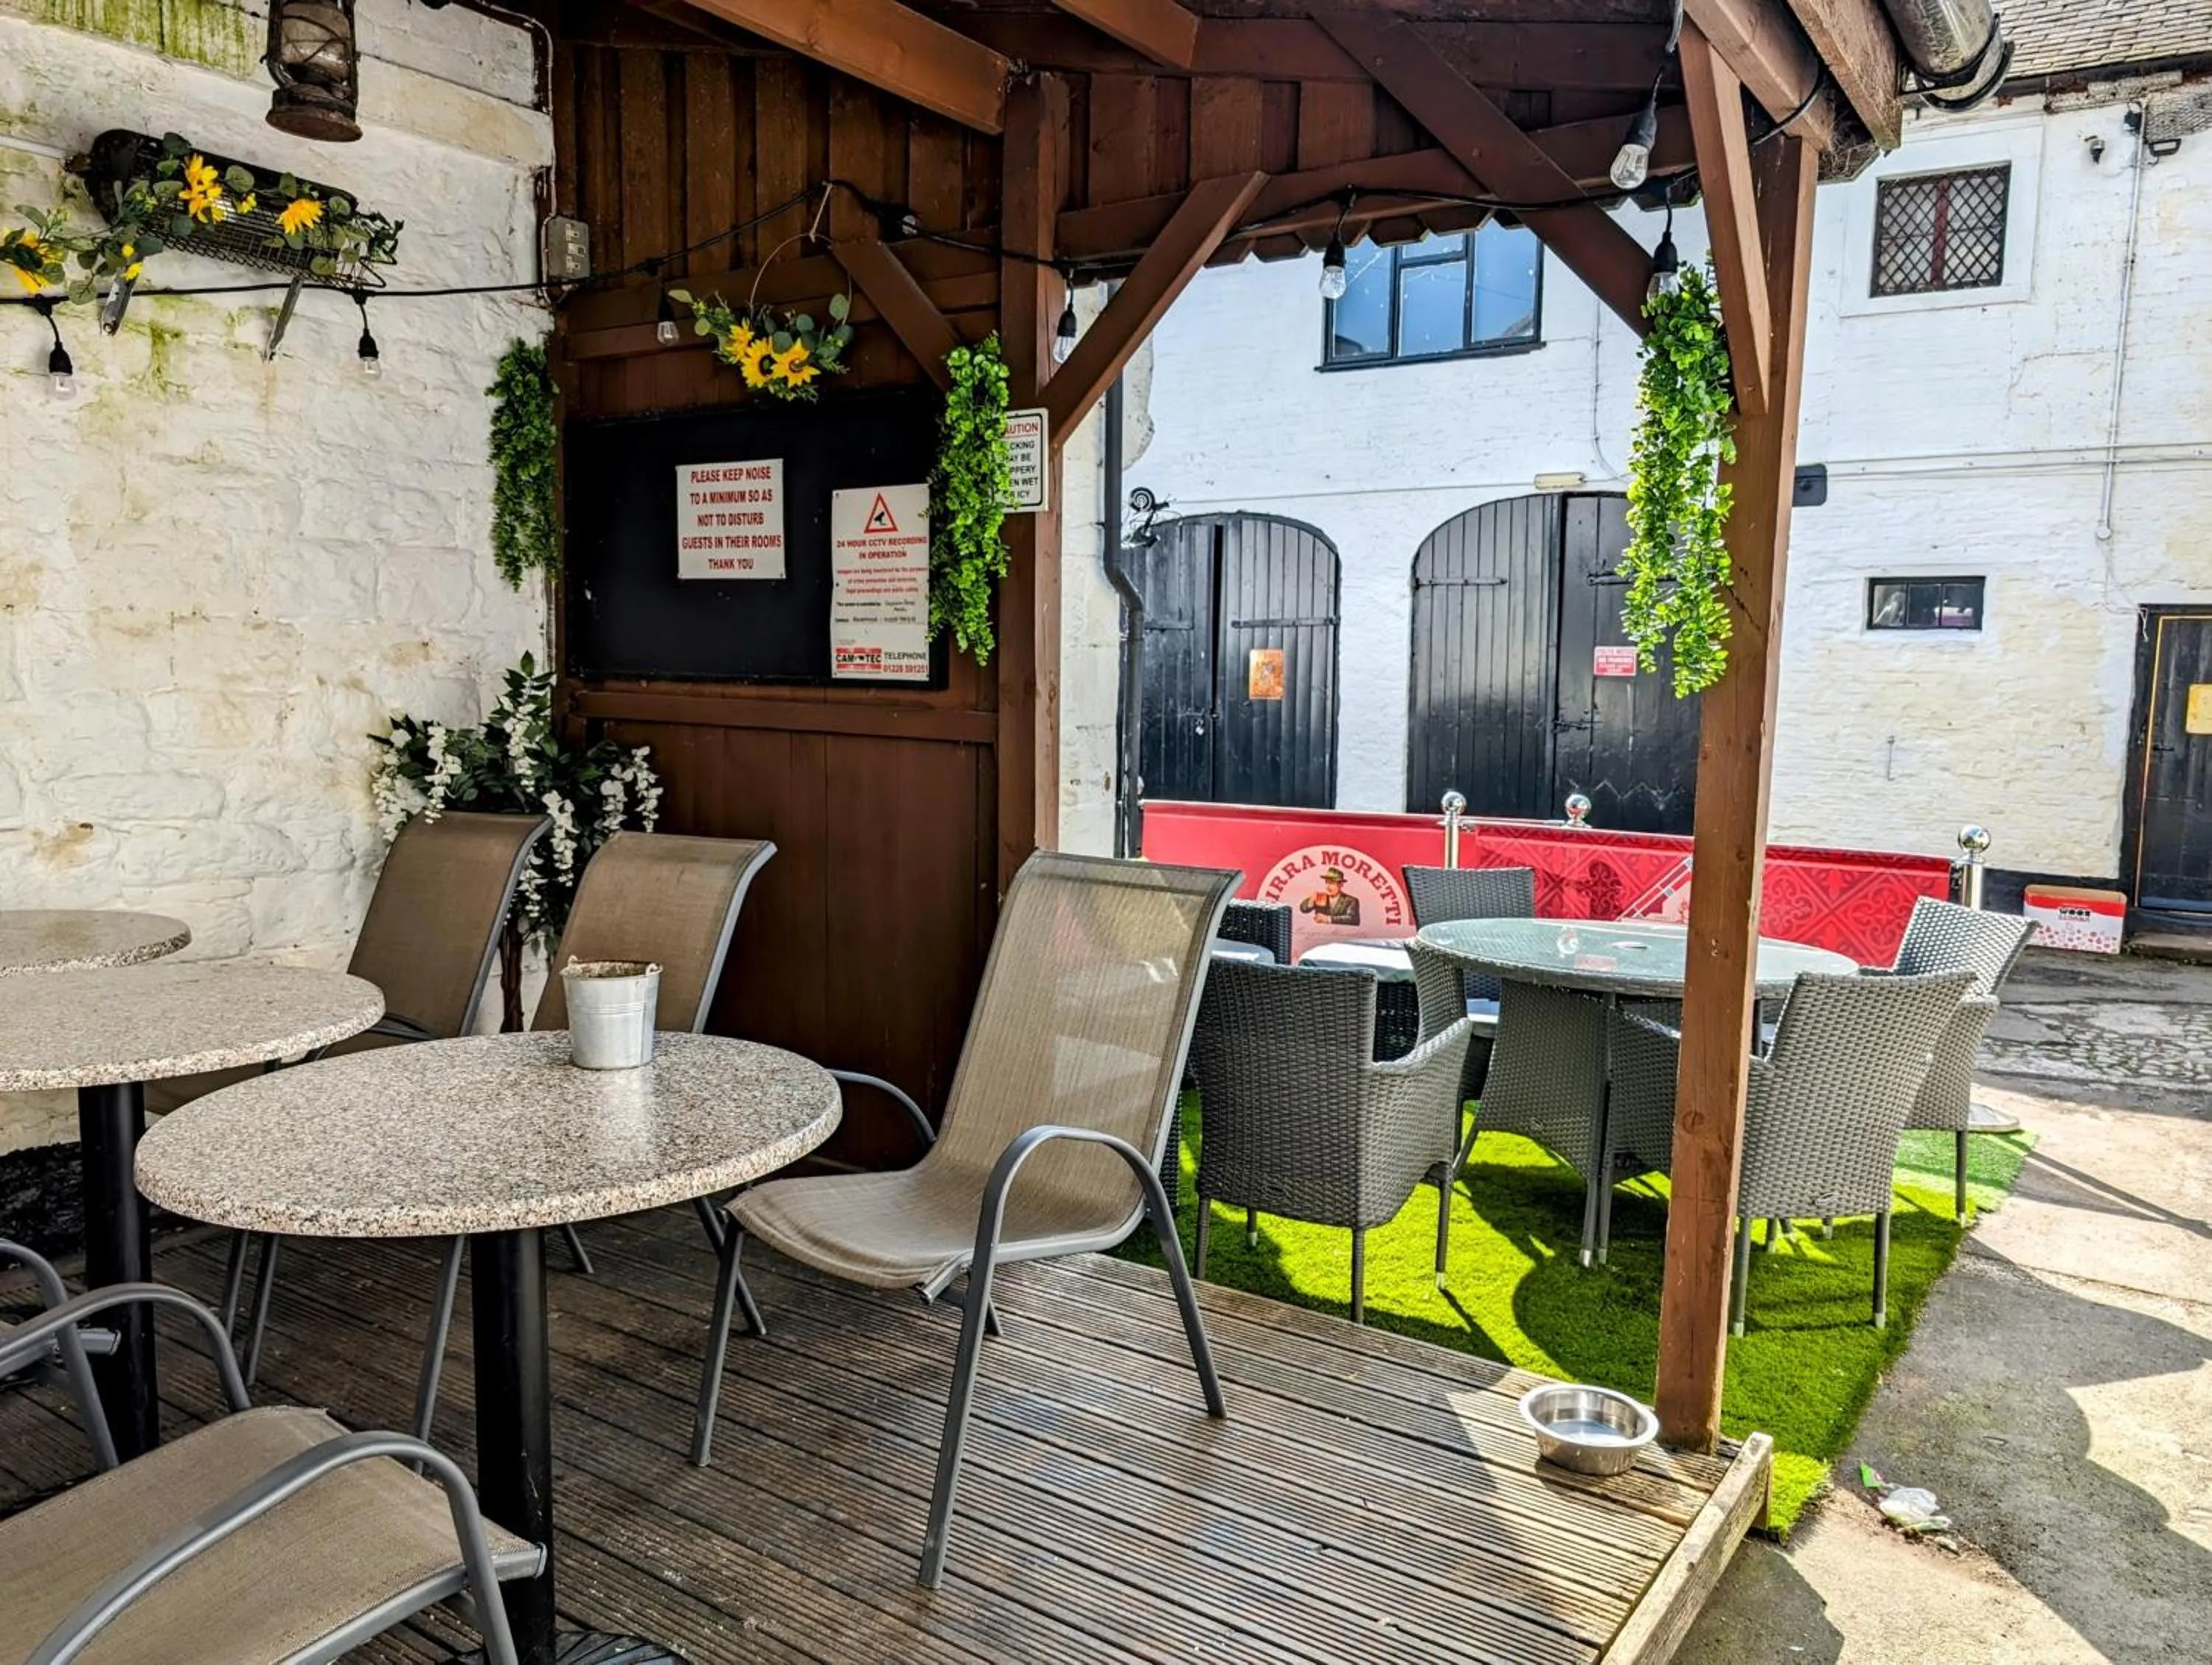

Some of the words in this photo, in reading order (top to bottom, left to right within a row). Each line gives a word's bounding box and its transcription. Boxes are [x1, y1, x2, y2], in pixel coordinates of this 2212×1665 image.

[1004, 423, 1038, 434] AUTION
[1009, 440, 1034, 451] CKING
[1020, 453, 1032, 462] BE
[691, 469, 720, 484] PLEASE
[723, 468, 744, 482] KEEP
[745, 466, 771, 480] NOISE
[1009, 465, 1035, 474] PPERY
[1009, 479, 1020, 487] EN
[1021, 477, 1038, 486] WET
[690, 493, 701, 505] TO
[702, 492, 709, 504] A
[709, 490, 747, 504] MINIMUM
[748, 490, 759, 503] SO
[762, 489, 773, 502] AS
[1018, 490, 1030, 499] ICY
[698, 514, 714, 526] NOT
[716, 513, 726, 526] TO
[728, 512, 765, 526] DISTURB
[682, 536, 713, 549] GUESTS
[714, 536, 723, 549] IN
[725, 535, 750, 549] THEIR
[751, 535, 782, 548] ROOMS
[837, 540, 846, 548] 24
[847, 539, 866, 547] HOUR
[868, 538, 886, 546] CCTV
[888, 536, 927, 546] RECORDING
[858, 552, 867, 560] IN
[869, 551, 908, 560] OPERATION
[708, 558, 735, 570] THANK
[737, 558, 754, 570] YOU
[884, 651, 927, 661] TELEPHONE
[1265, 855, 1316, 903] IRRA
[1321, 850, 1401, 925] MORETTI
